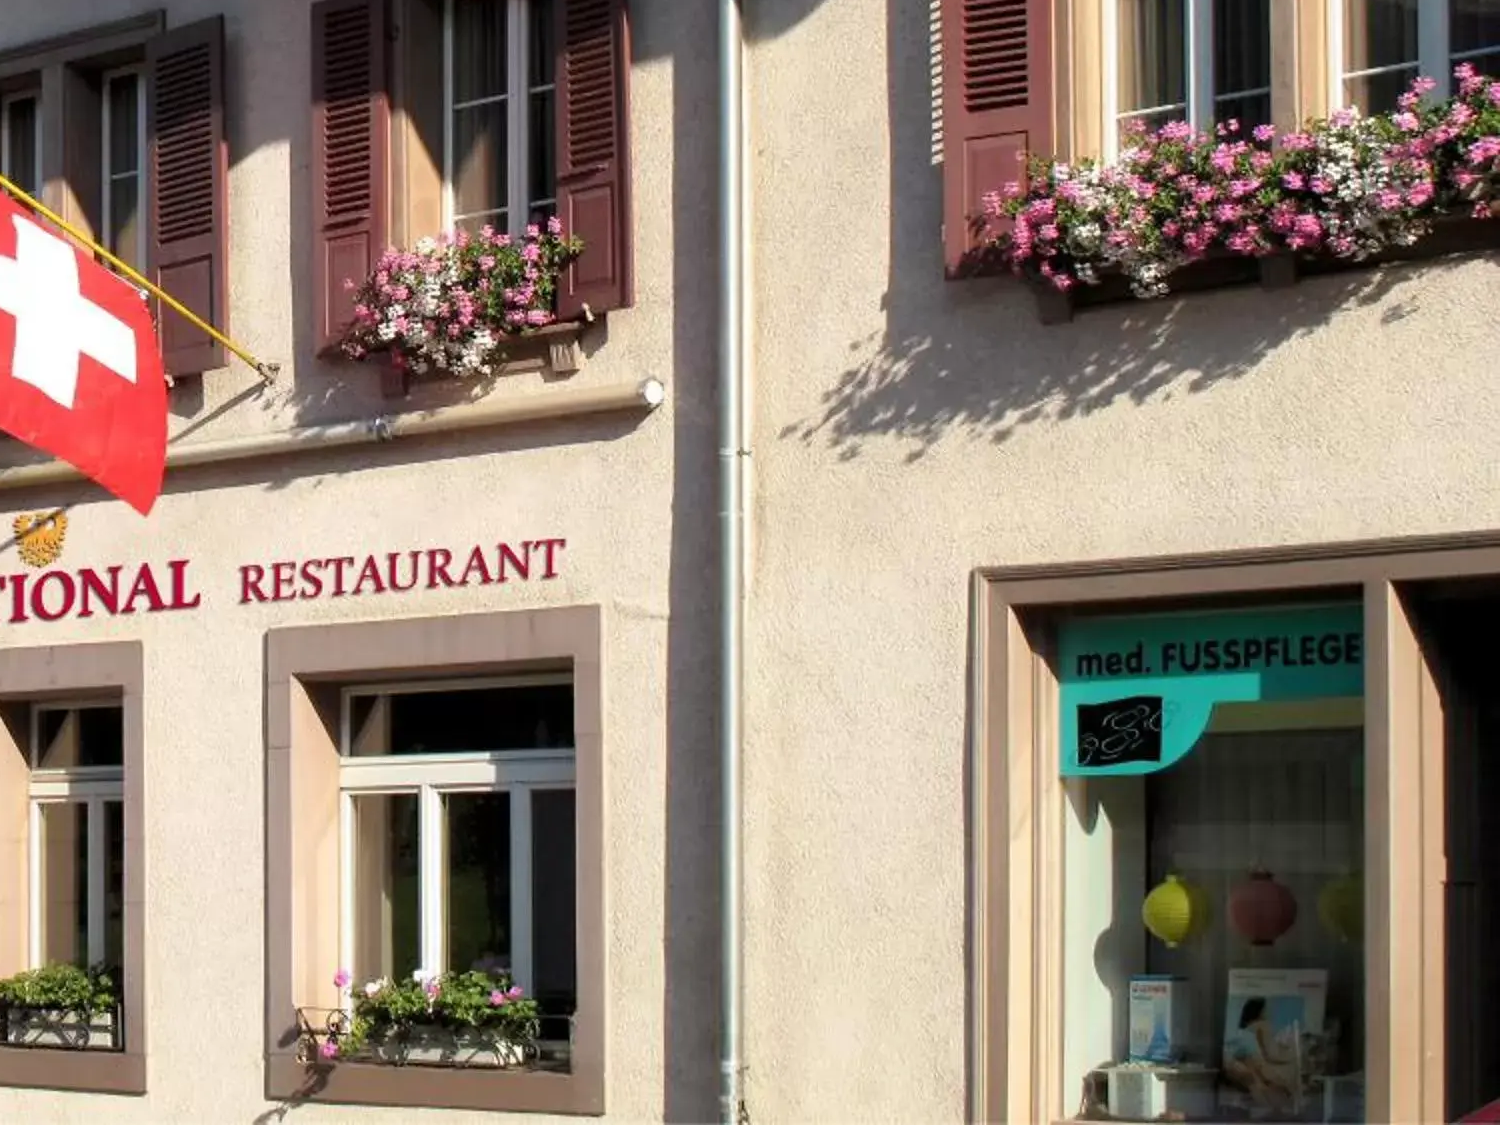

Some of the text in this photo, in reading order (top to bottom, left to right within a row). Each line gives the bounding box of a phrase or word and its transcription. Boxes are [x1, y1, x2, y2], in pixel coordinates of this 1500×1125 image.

[237, 537, 567, 606] RESTAURANT
[1076, 633, 1363, 676] med. FUSSPFLEGE
